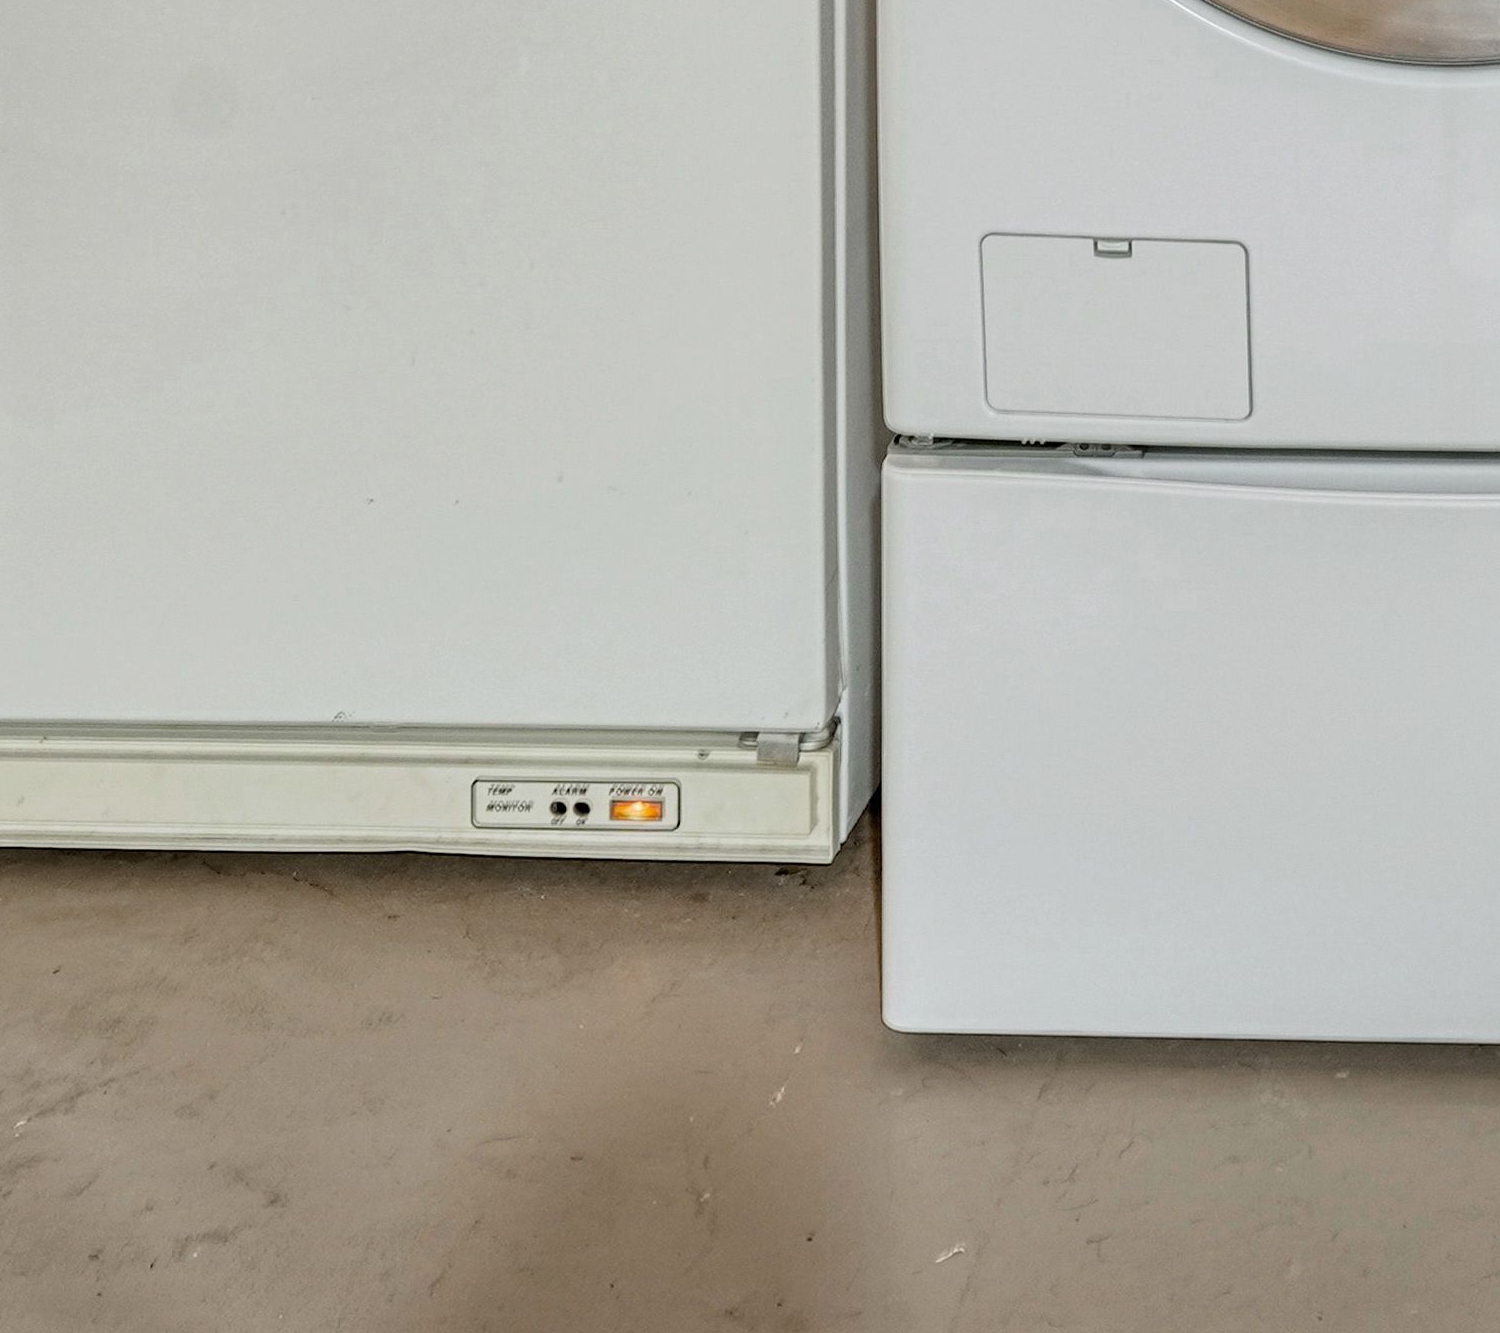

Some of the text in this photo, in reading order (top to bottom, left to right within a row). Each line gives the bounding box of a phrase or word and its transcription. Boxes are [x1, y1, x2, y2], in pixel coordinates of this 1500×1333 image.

[487, 785, 515, 796] TEMP
[552, 784, 589, 796] ALARM
[608, 784, 663, 796] POWER ON
[486, 800, 533, 812] MONITOR
